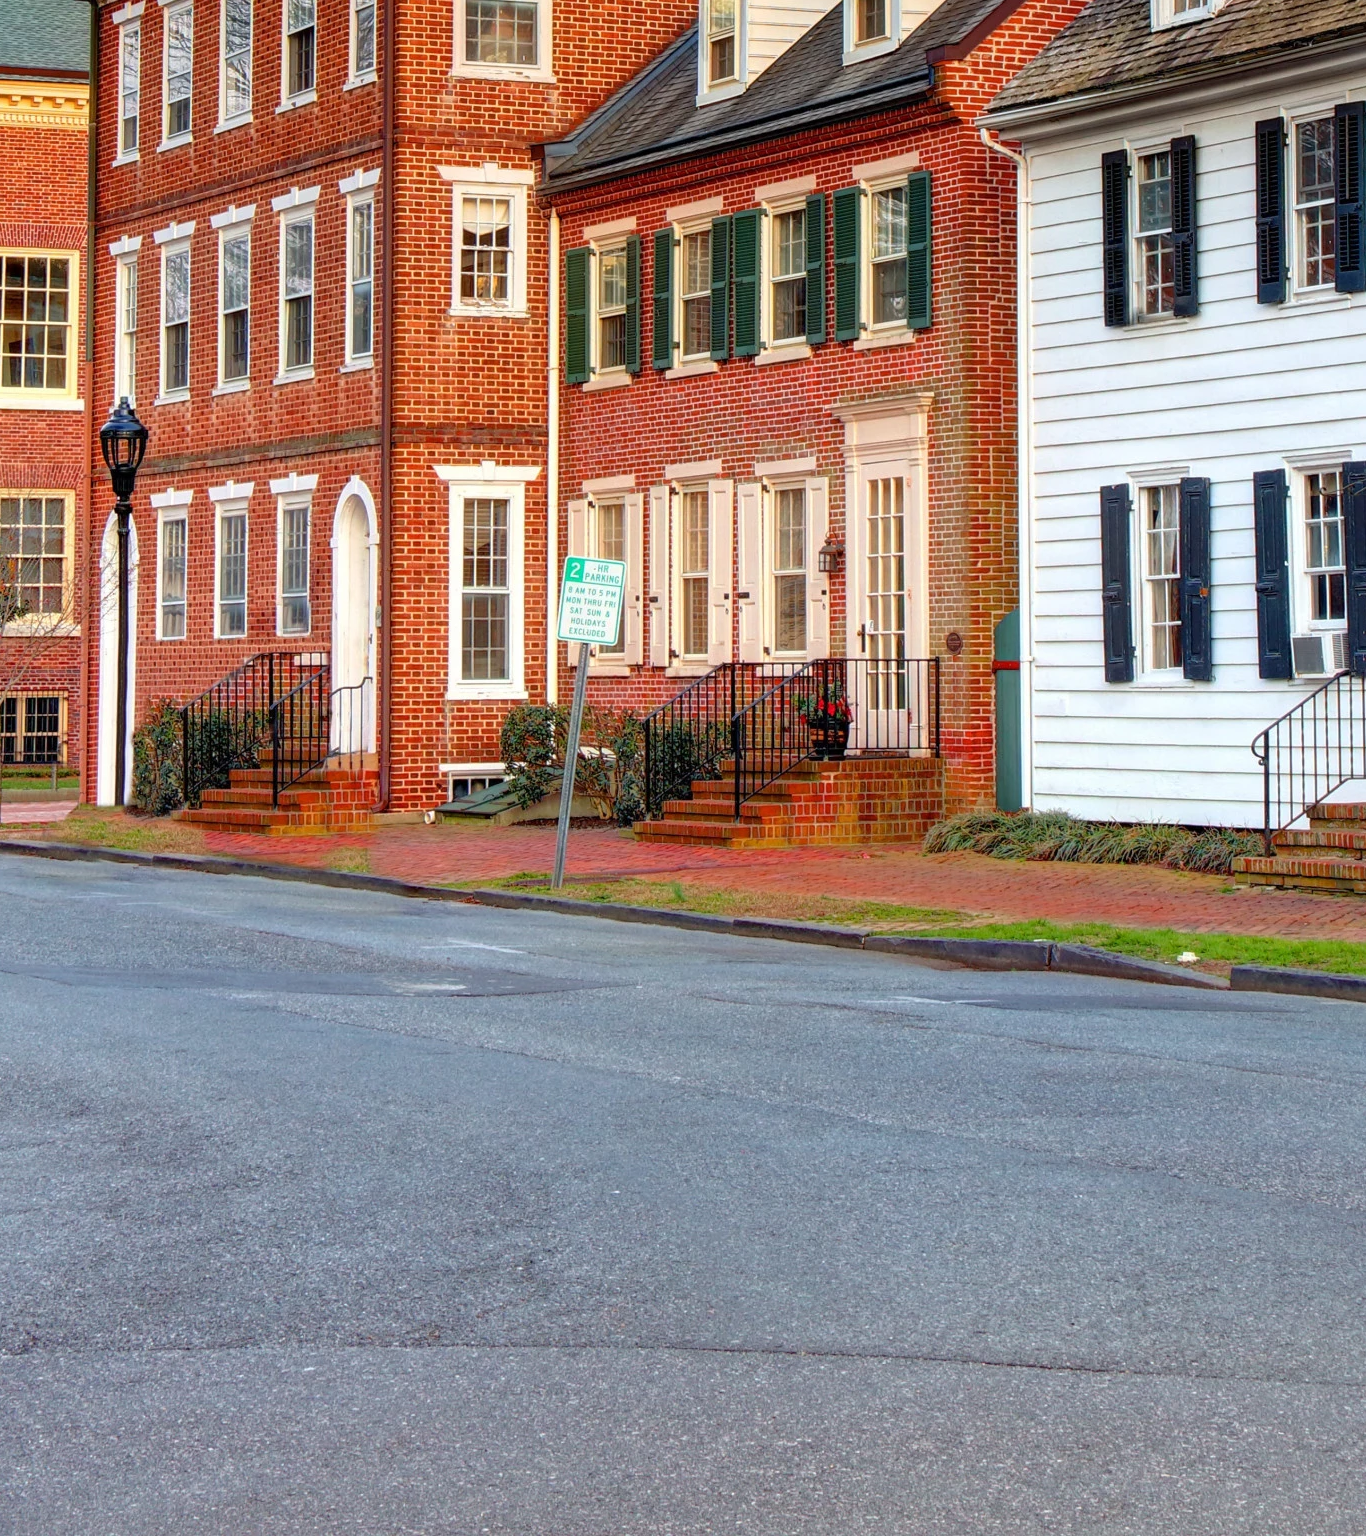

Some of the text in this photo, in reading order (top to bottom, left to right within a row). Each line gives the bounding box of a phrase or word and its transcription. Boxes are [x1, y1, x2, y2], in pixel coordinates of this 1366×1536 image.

[570, 562, 581, 578] 2
[584, 572, 620, 584] PARKING
[575, 586, 586, 595] AM
[588, 588, 597, 596] TO
[599, 589, 604, 597] 5
[606, 590, 617, 598] PM
[566, 596, 616, 608] MON THRU FRI
[570, 606, 583, 615] SAT
[587, 608, 602, 617] SUN
[570, 617, 607, 628] HOLIDAYS
[569, 627, 606, 638] EXCLUDED
